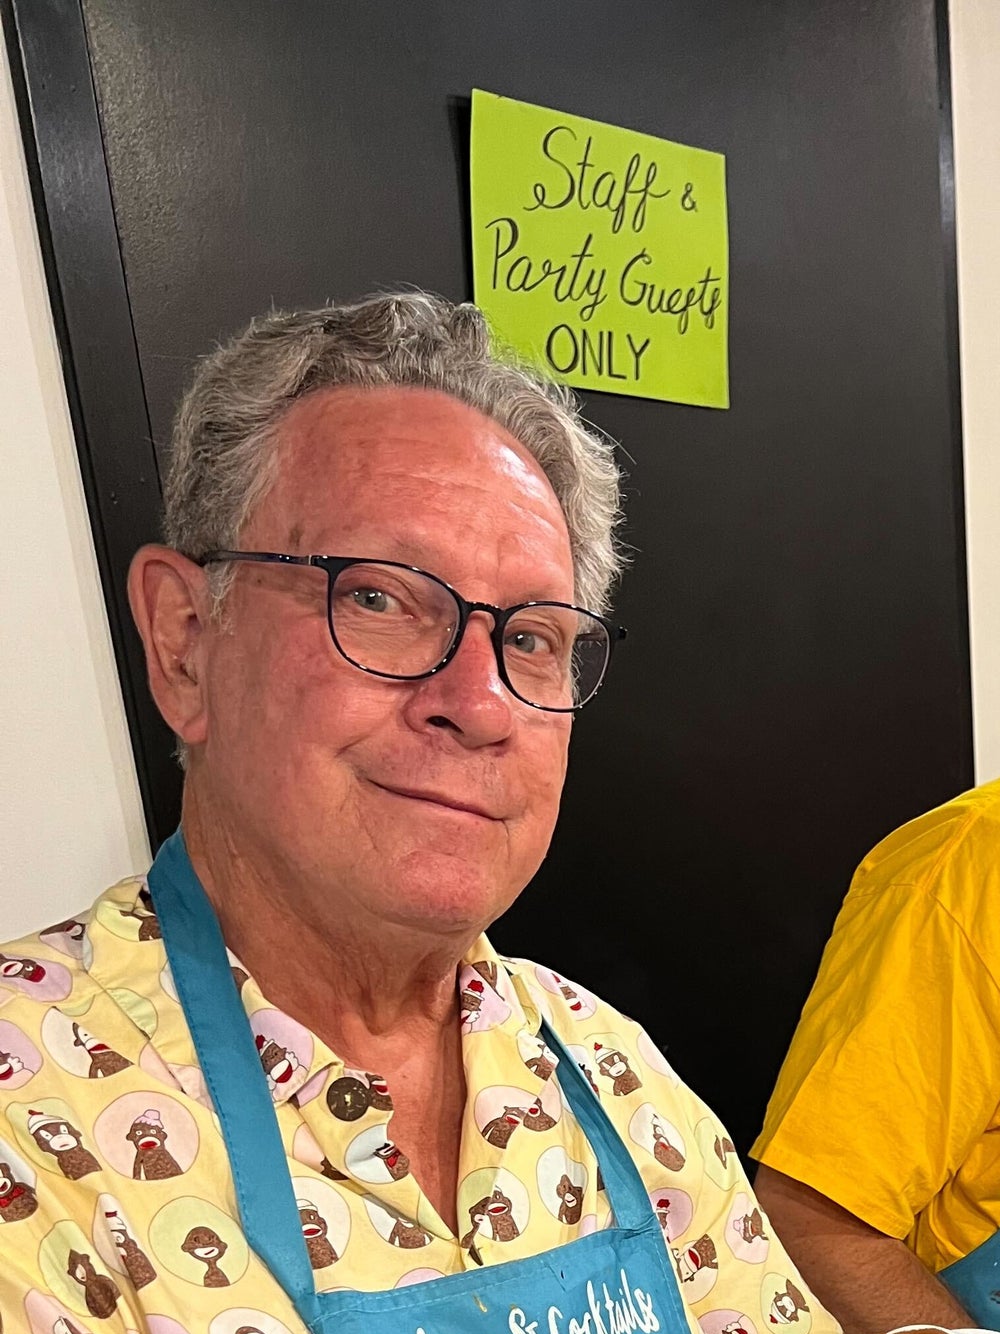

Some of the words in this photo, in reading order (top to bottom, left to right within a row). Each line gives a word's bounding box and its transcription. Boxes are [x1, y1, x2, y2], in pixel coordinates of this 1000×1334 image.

[523, 126, 671, 234] Staff
[681, 182, 698, 212] &
[485, 217, 608, 321] Party
[620, 248, 722, 335] Guests
[546, 324, 650, 381] ONLY
